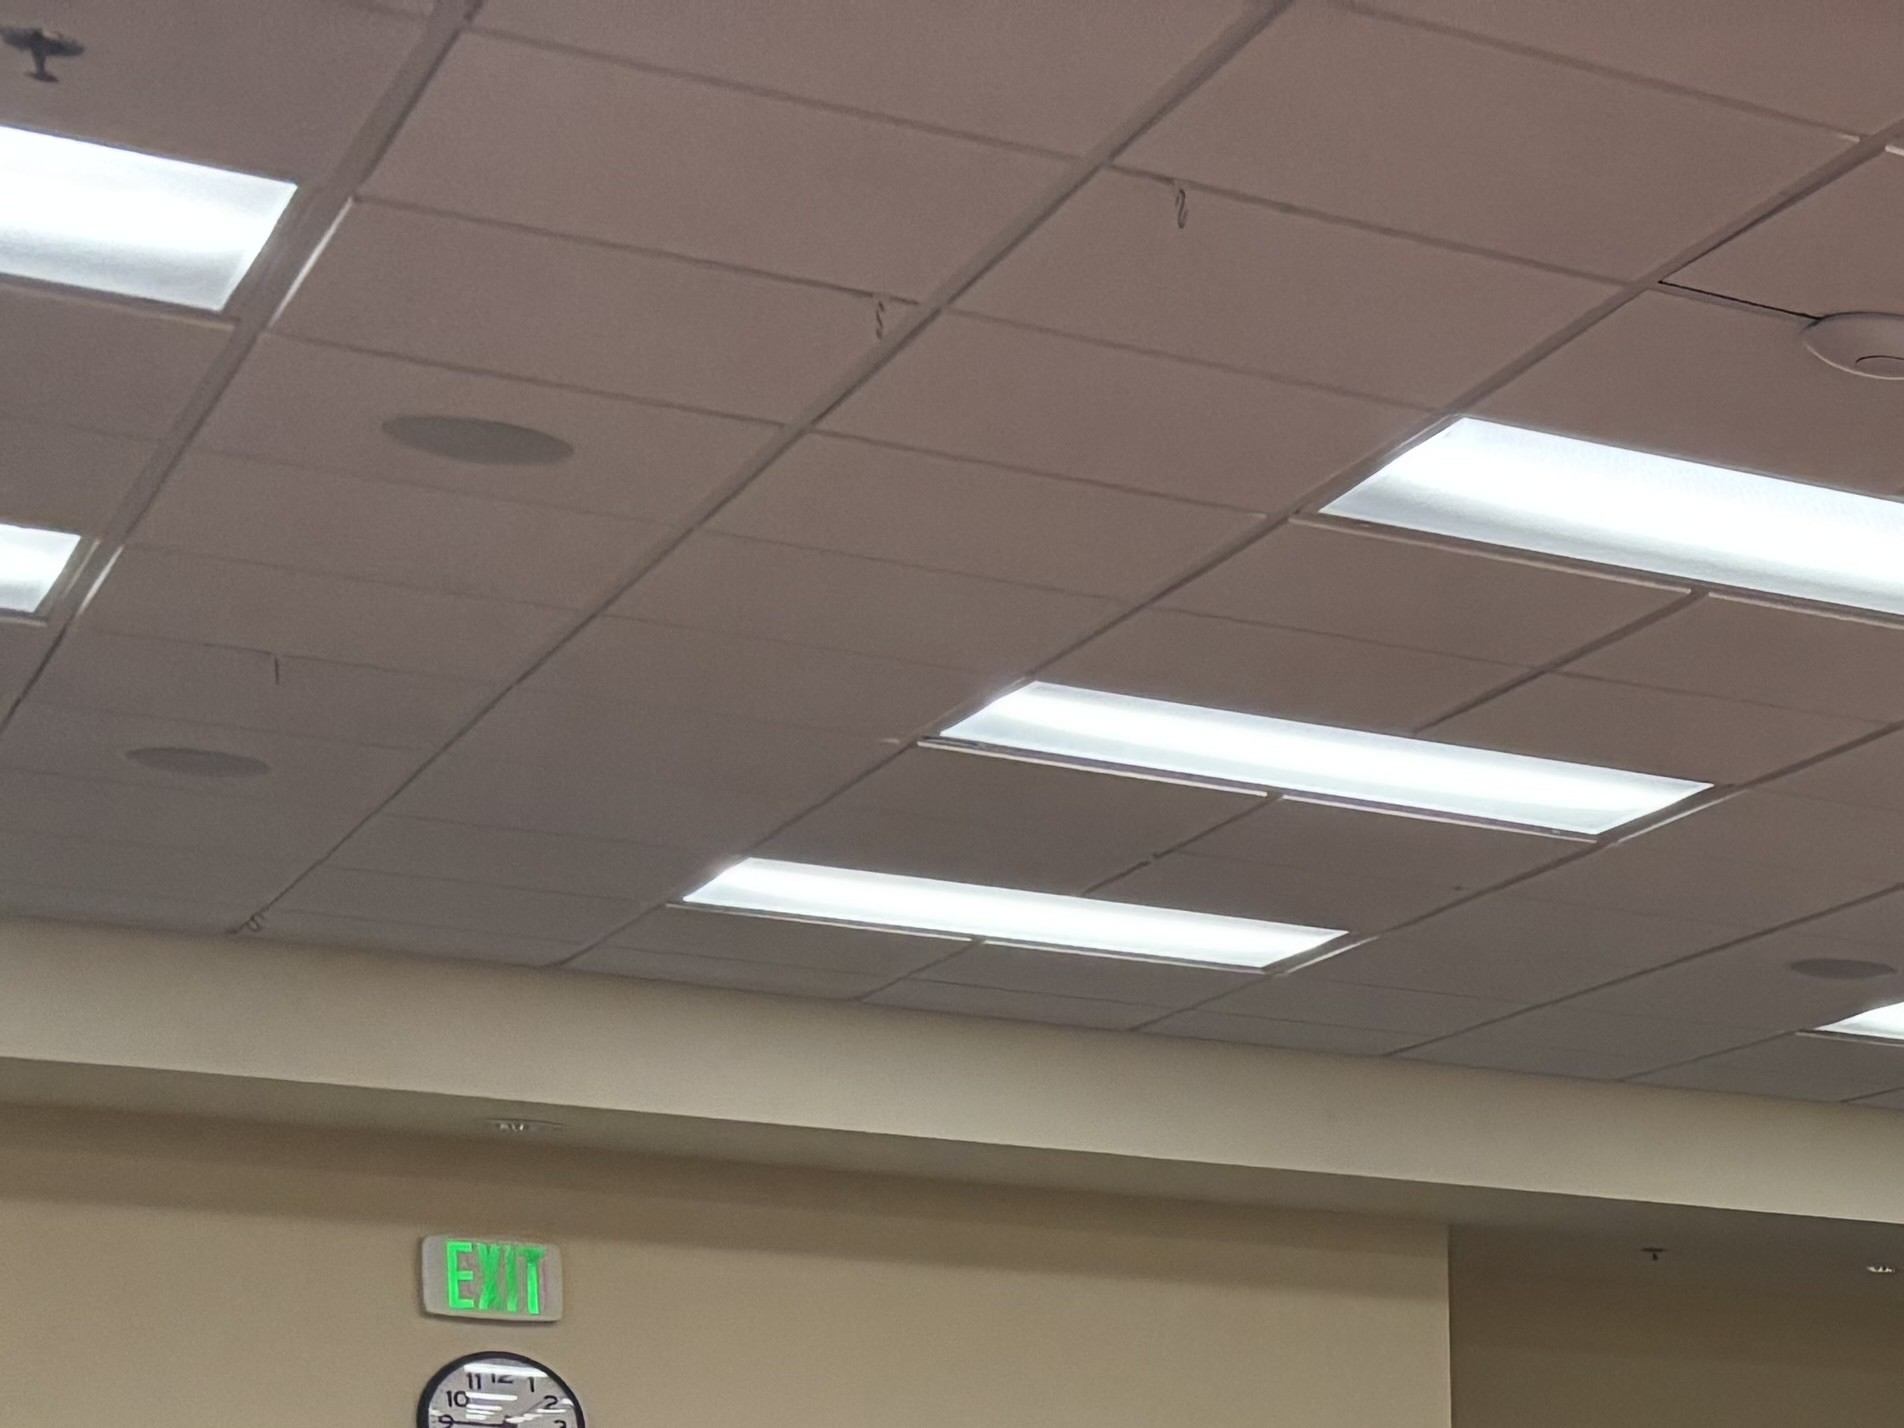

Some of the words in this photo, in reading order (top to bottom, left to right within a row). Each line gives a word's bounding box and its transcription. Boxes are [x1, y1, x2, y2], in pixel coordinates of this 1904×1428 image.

[446, 1241, 546, 1316] EXIT
[467, 1373, 482, 1390] 11
[528, 1376, 535, 1393] 1
[446, 1390, 469, 1408] 10
[543, 1394, 558, 1409] 2
